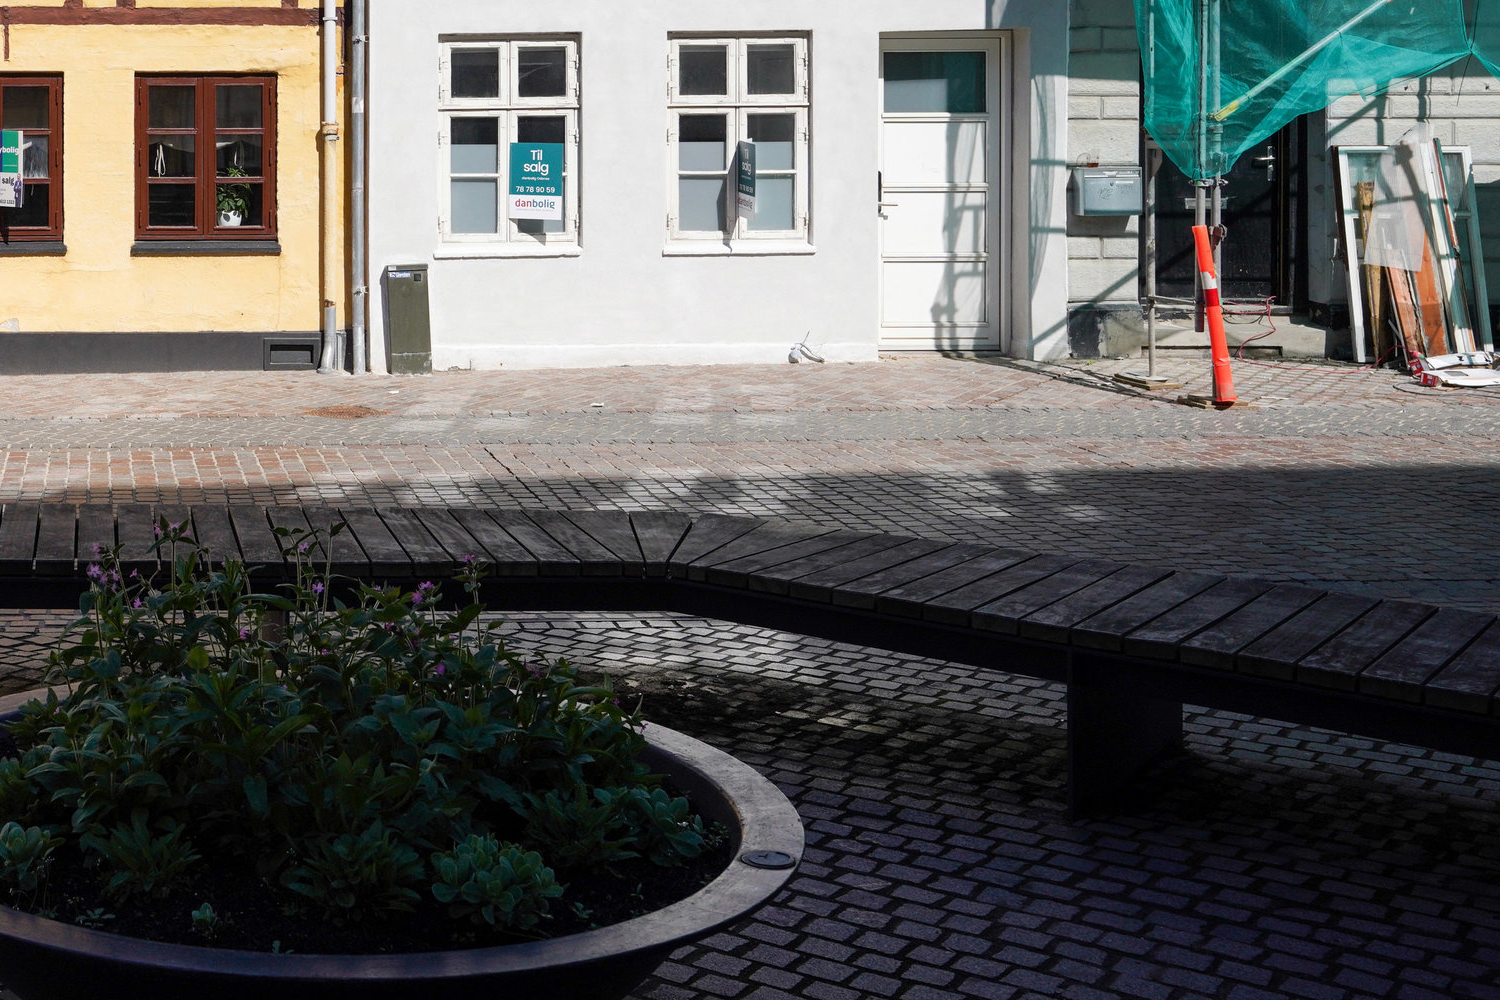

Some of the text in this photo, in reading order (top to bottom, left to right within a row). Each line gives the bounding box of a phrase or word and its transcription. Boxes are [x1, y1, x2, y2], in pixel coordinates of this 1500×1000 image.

[530, 150, 543, 160] Til
[524, 161, 549, 176] salg
[2, 176, 14, 186] salg
[515, 198, 555, 210] danbolig
